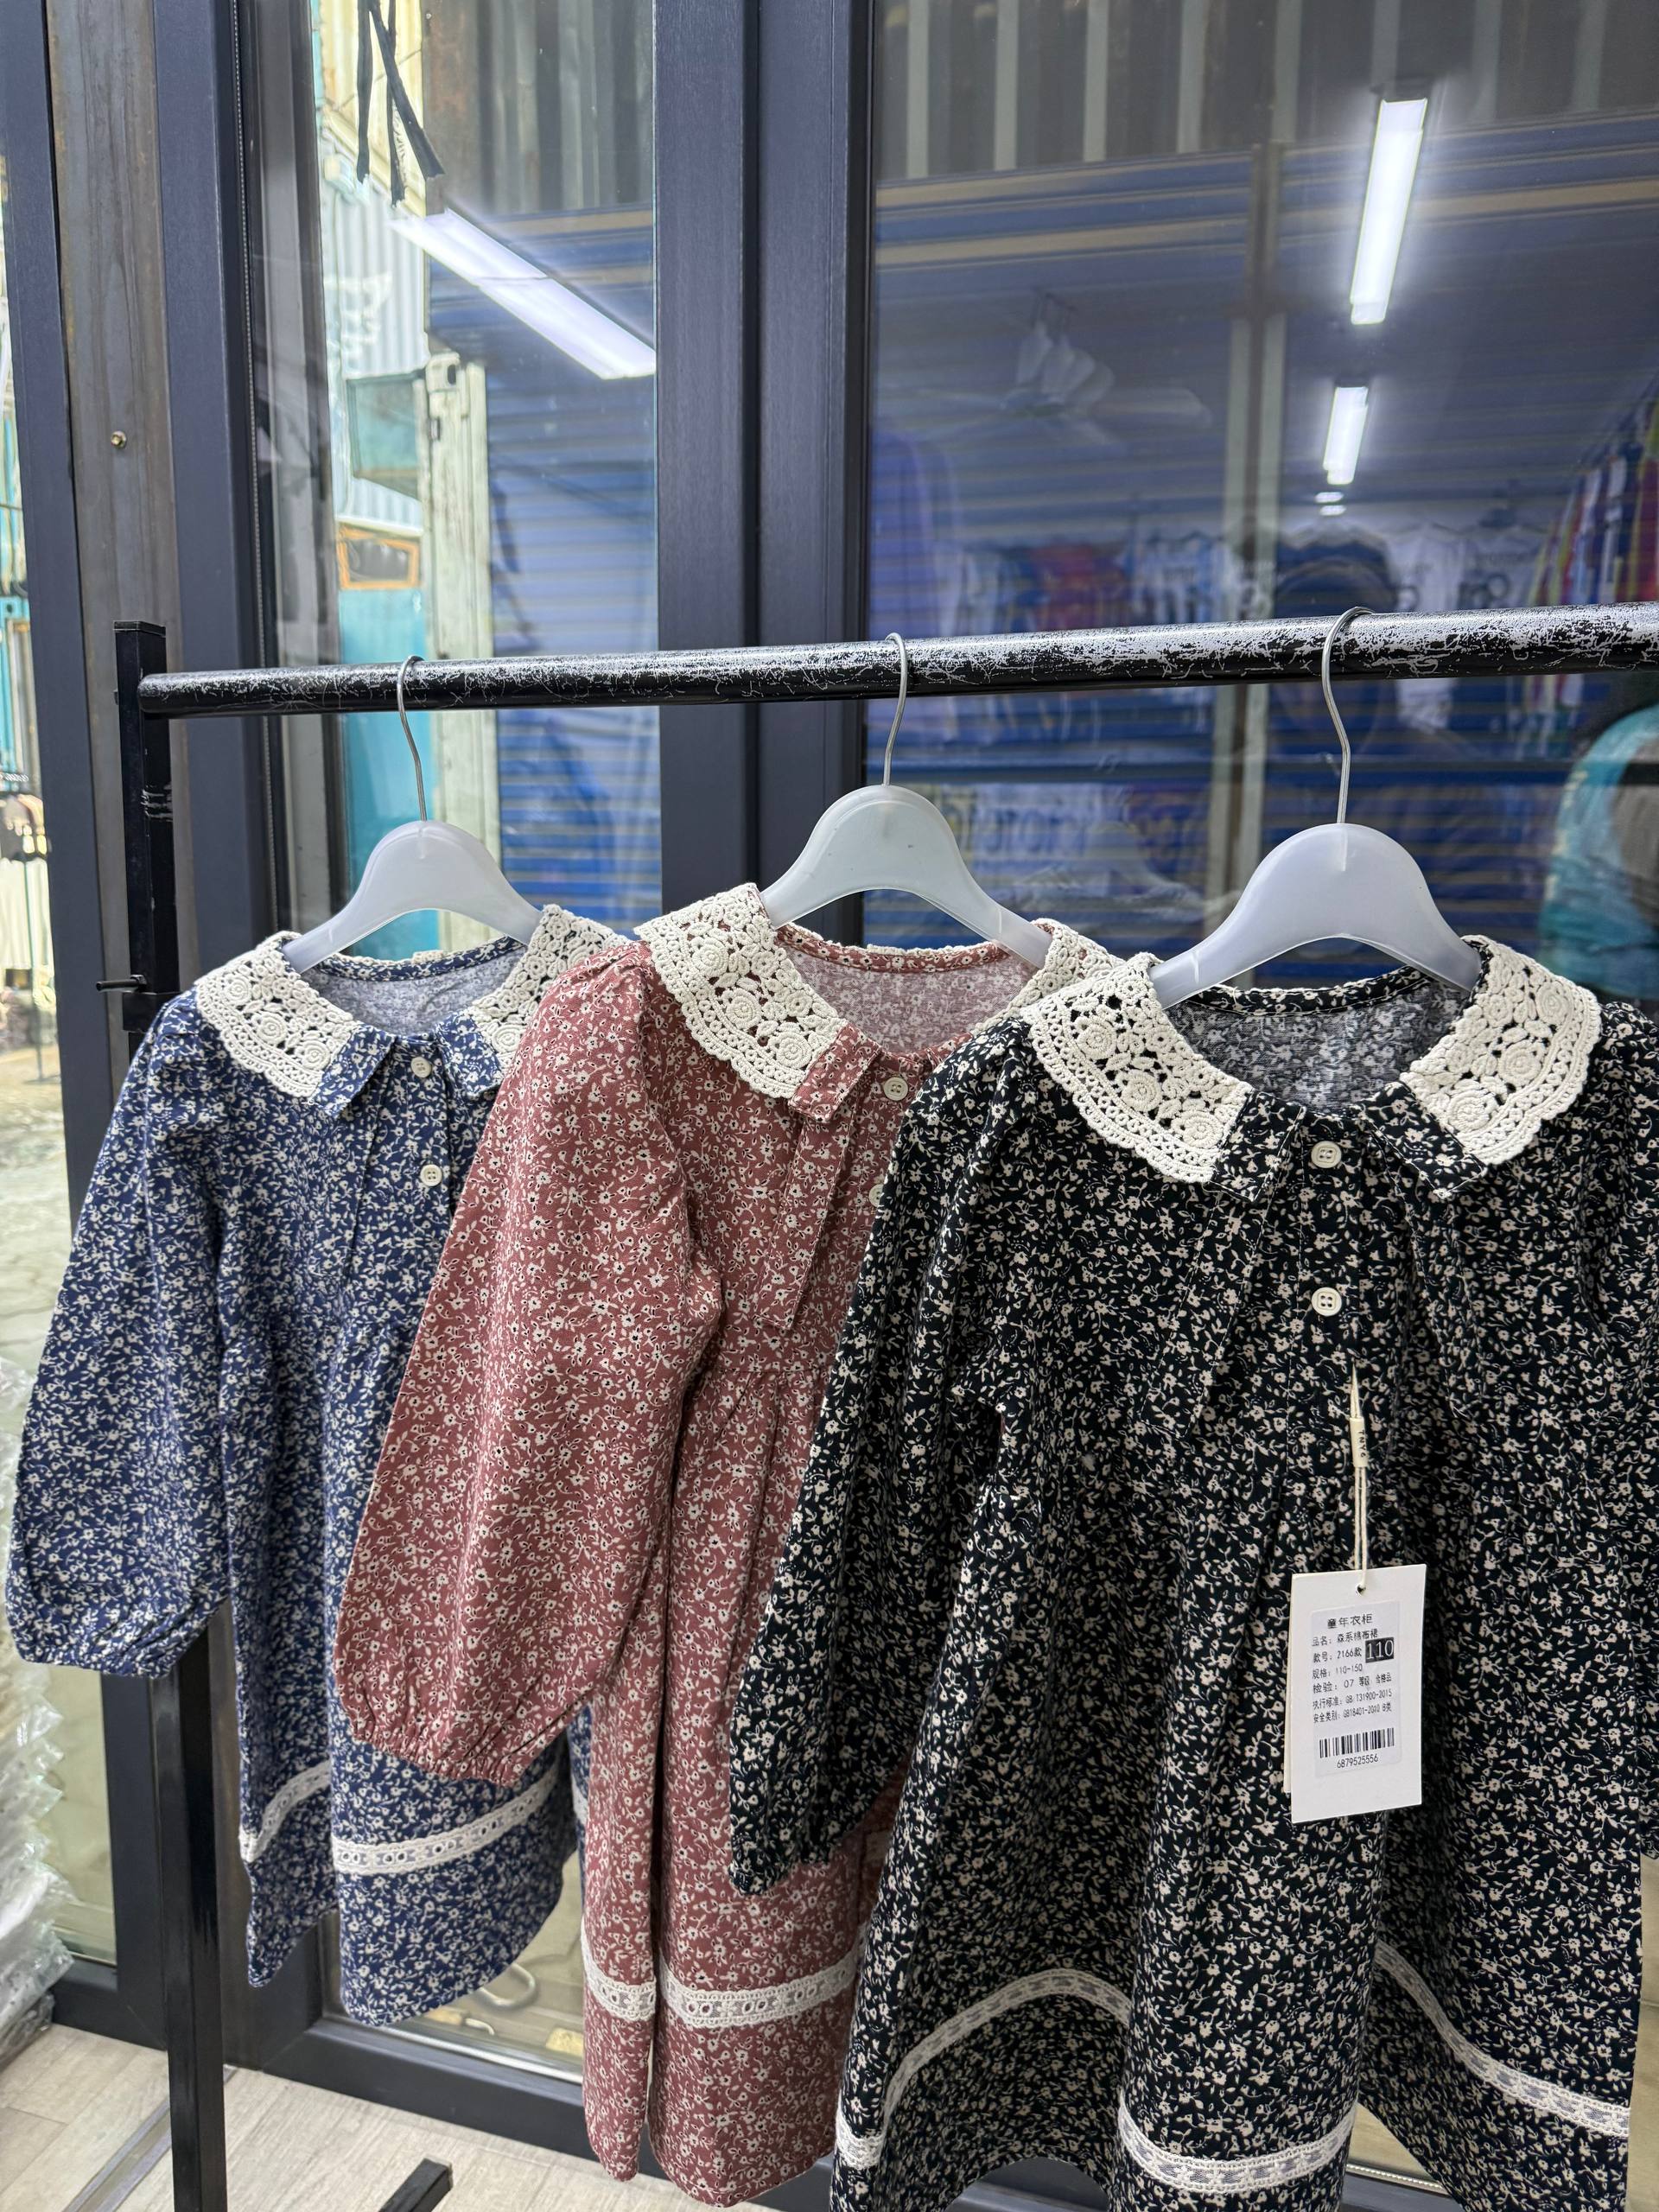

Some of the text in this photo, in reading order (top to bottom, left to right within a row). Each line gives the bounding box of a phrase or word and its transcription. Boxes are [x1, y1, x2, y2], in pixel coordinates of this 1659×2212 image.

[1327, 1613, 1372, 1629] 童年衣柜
[1366, 1639, 1394, 1659] 110
[1337, 1753, 1378, 1769] 6879525556
